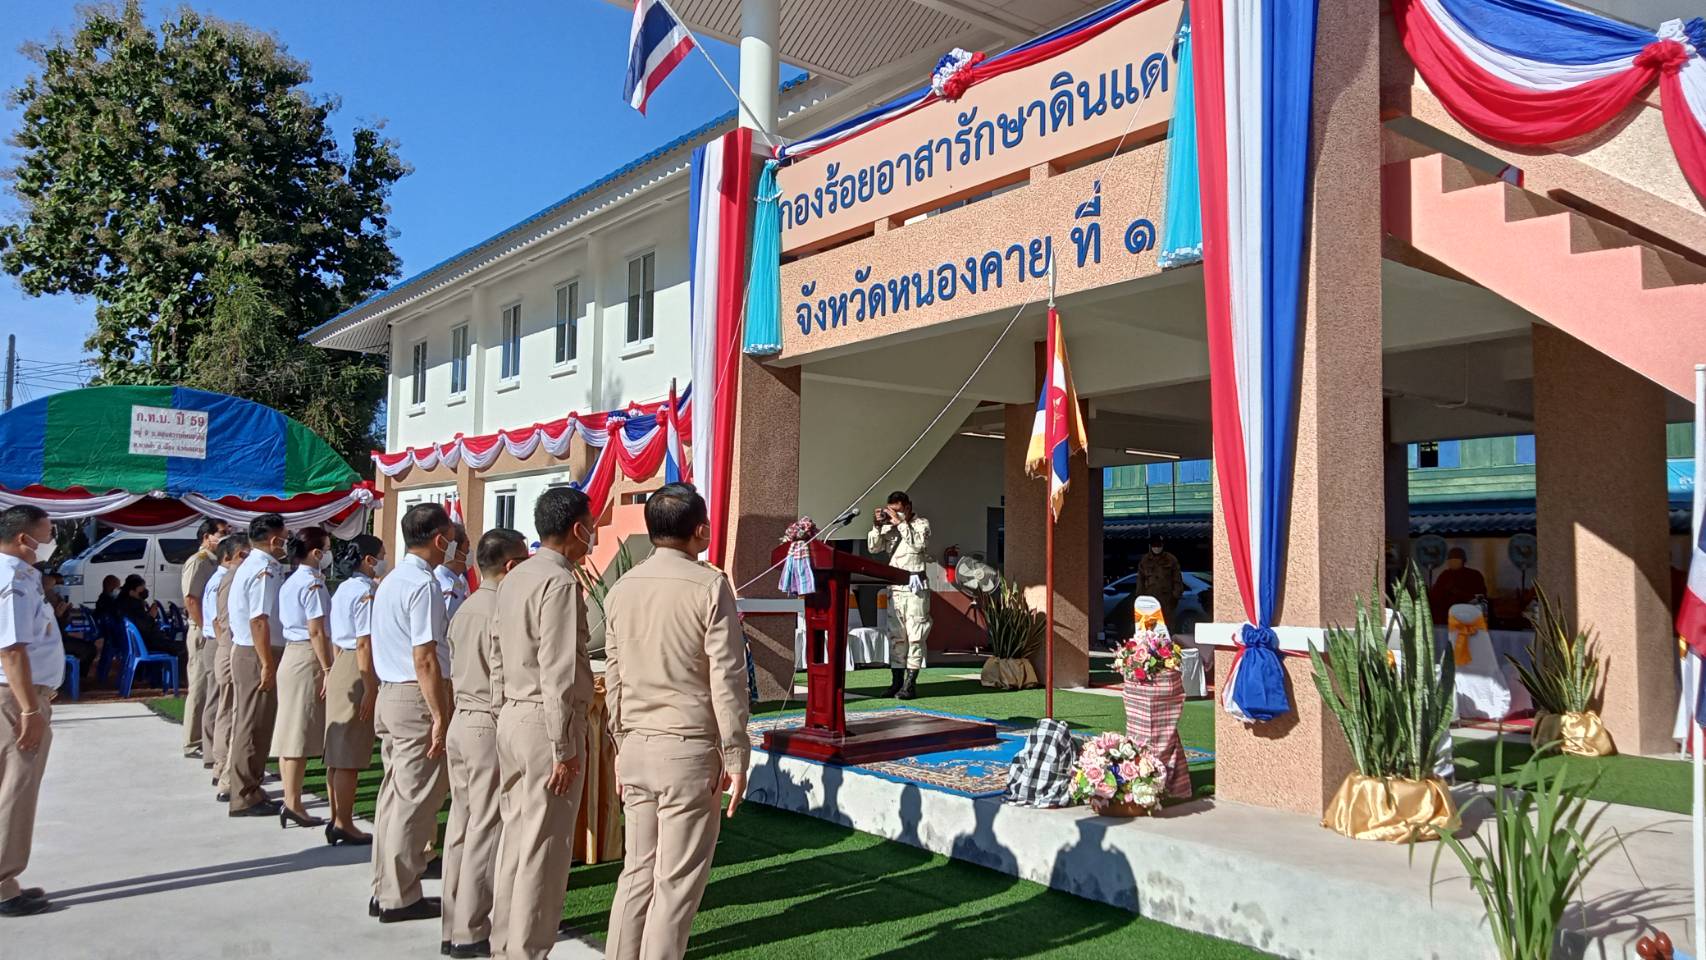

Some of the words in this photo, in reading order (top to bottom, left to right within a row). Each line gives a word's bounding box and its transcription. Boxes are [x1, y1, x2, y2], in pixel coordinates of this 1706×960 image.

[778, 40, 1179, 232] กองร้อยอาสารักษาดินแด
[796, 236, 1051, 335] จังหวัดหนองคาย
[1071, 180, 1101, 267] ที่
[1124, 218, 1155, 254] ๑
[176, 411, 185, 426] ปี
[190, 415, 205, 427] 59
